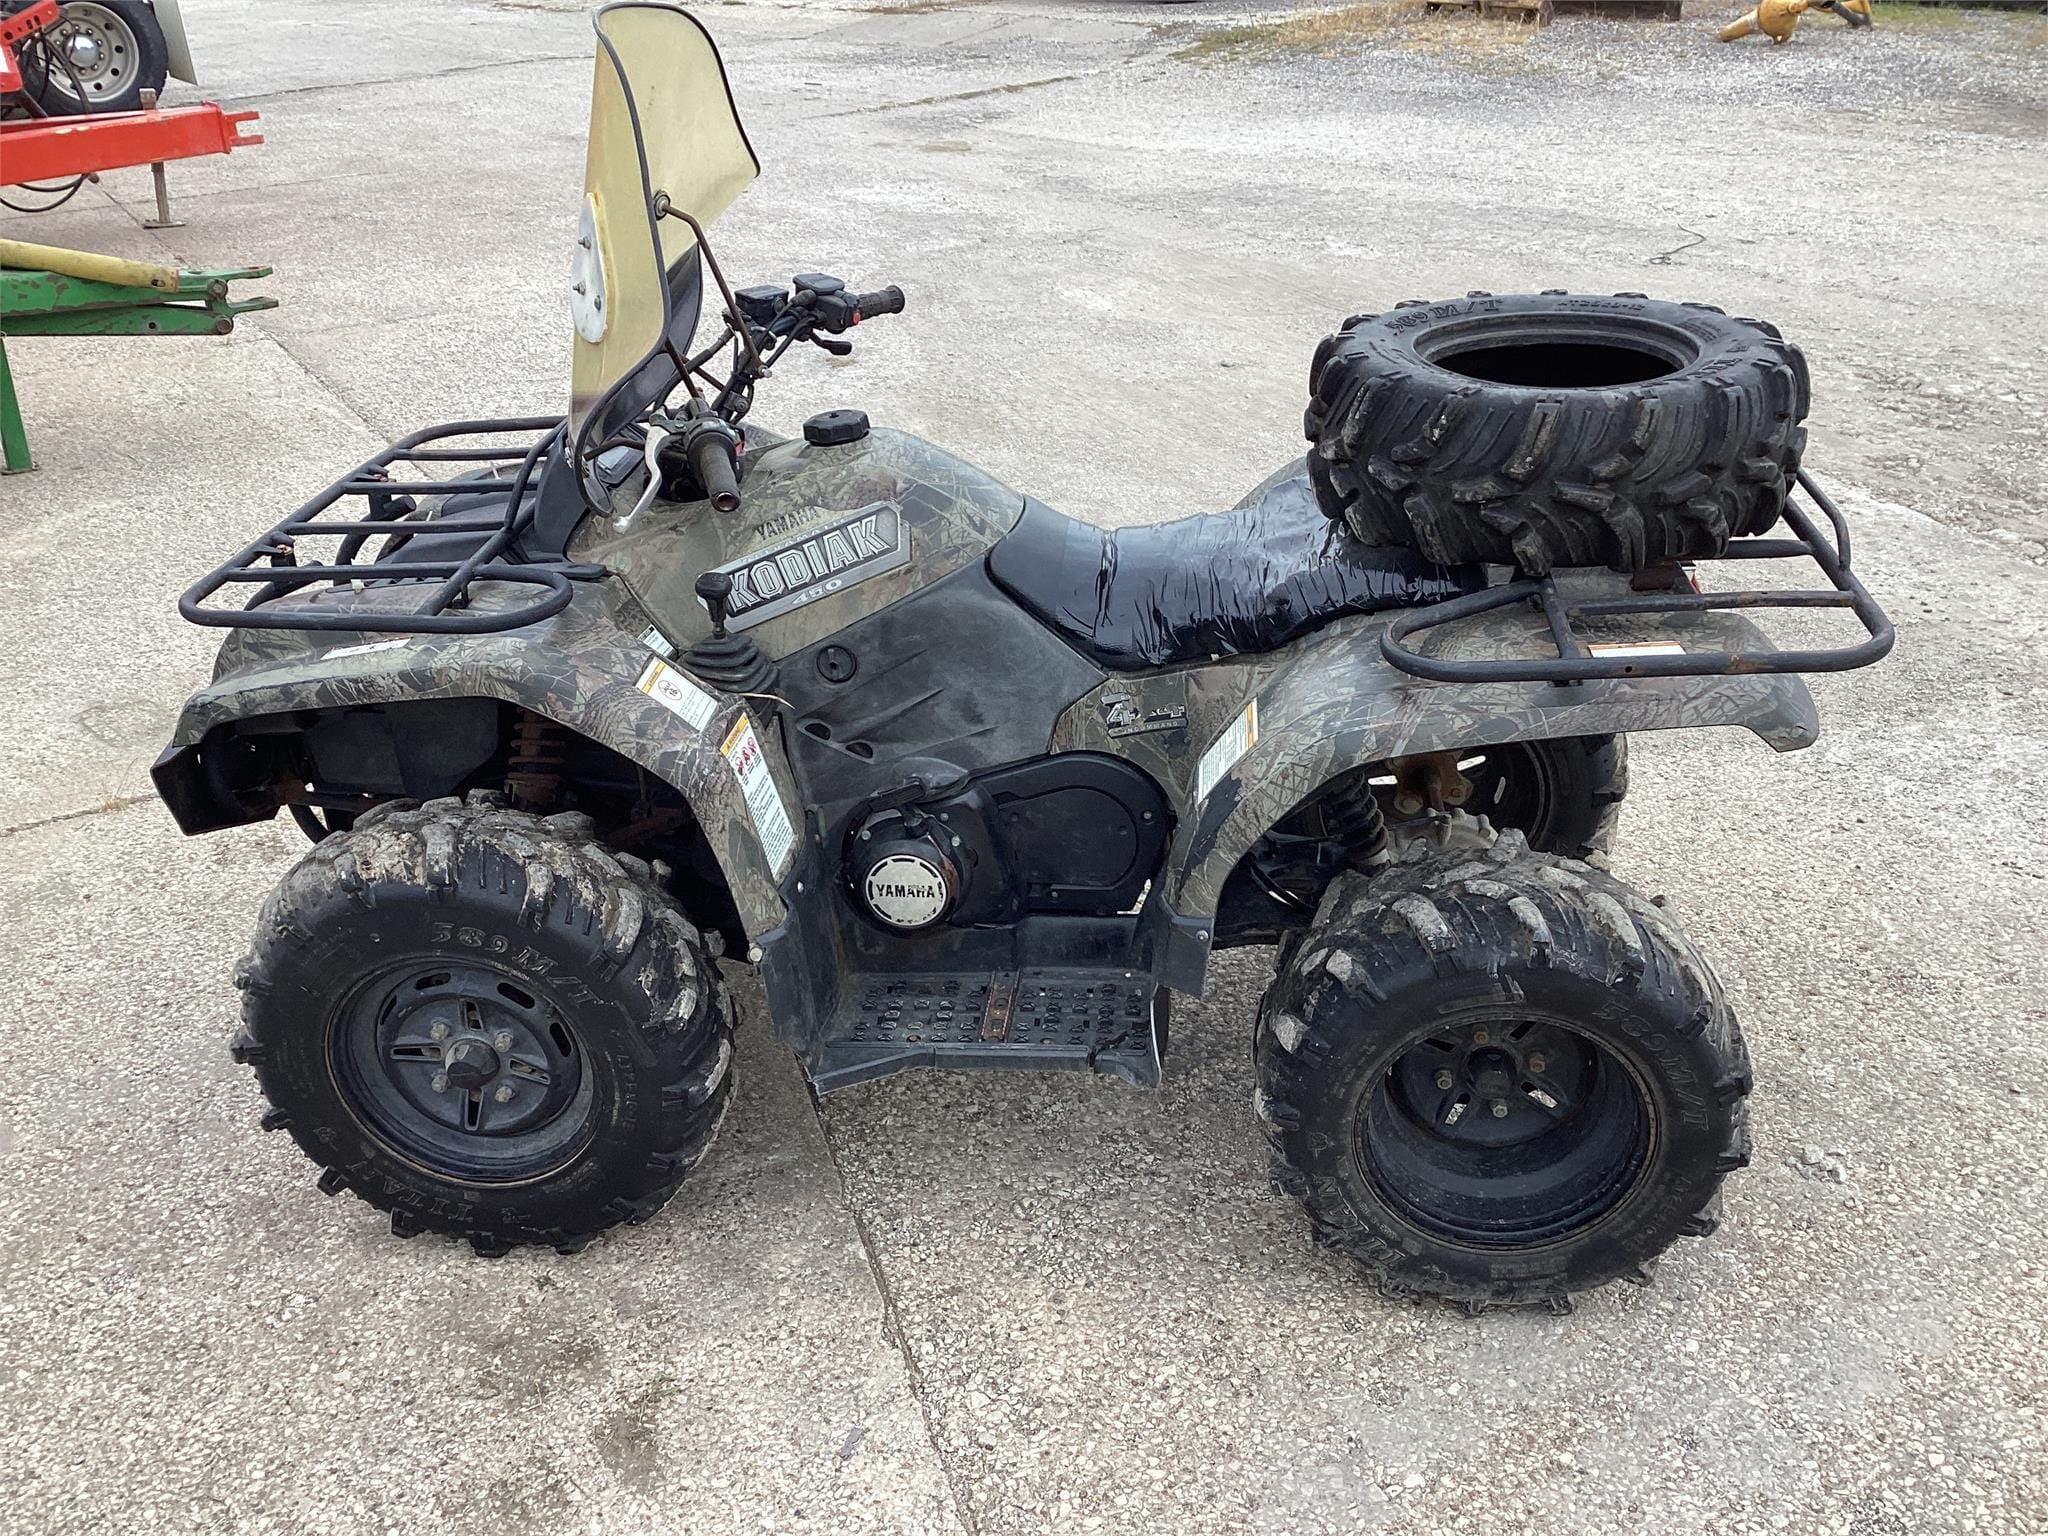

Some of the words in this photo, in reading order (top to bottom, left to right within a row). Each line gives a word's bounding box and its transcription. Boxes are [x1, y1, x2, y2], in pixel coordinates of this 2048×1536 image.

[1429, 298, 1503, 319] M/T
[754, 505, 818, 540] YAMAHA
[728, 514, 892, 612] KODIAK
[791, 578, 843, 605] 450
[876, 884, 936, 899] YAMAHA
[430, 921, 511, 954] 589
[511, 945, 603, 1008] M/T
